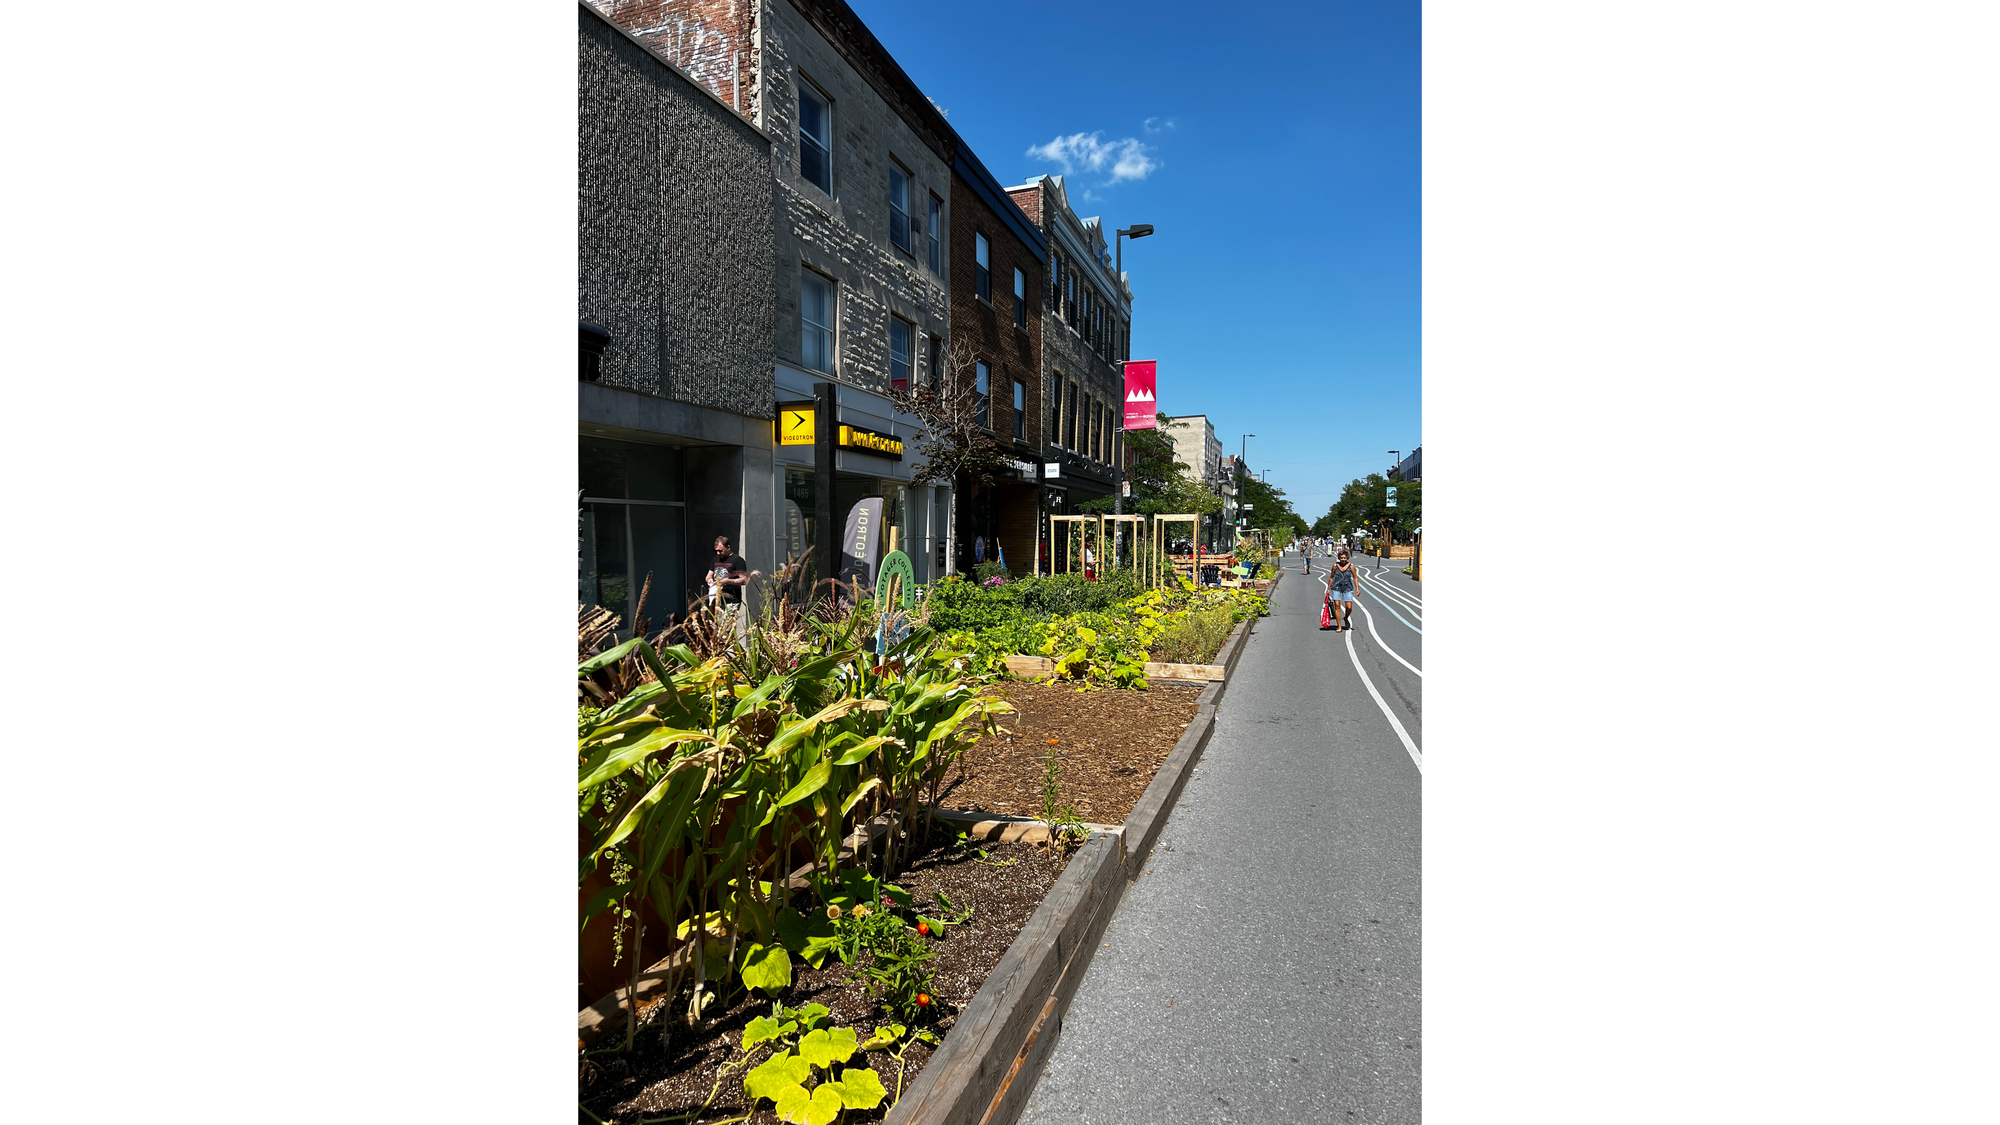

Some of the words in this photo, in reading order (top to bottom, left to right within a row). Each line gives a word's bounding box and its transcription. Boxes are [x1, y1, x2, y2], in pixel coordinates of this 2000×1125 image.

[793, 487, 809, 499] 1465
[880, 558, 897, 598] POTAGER
[898, 558, 912, 602] COLLECTIF
